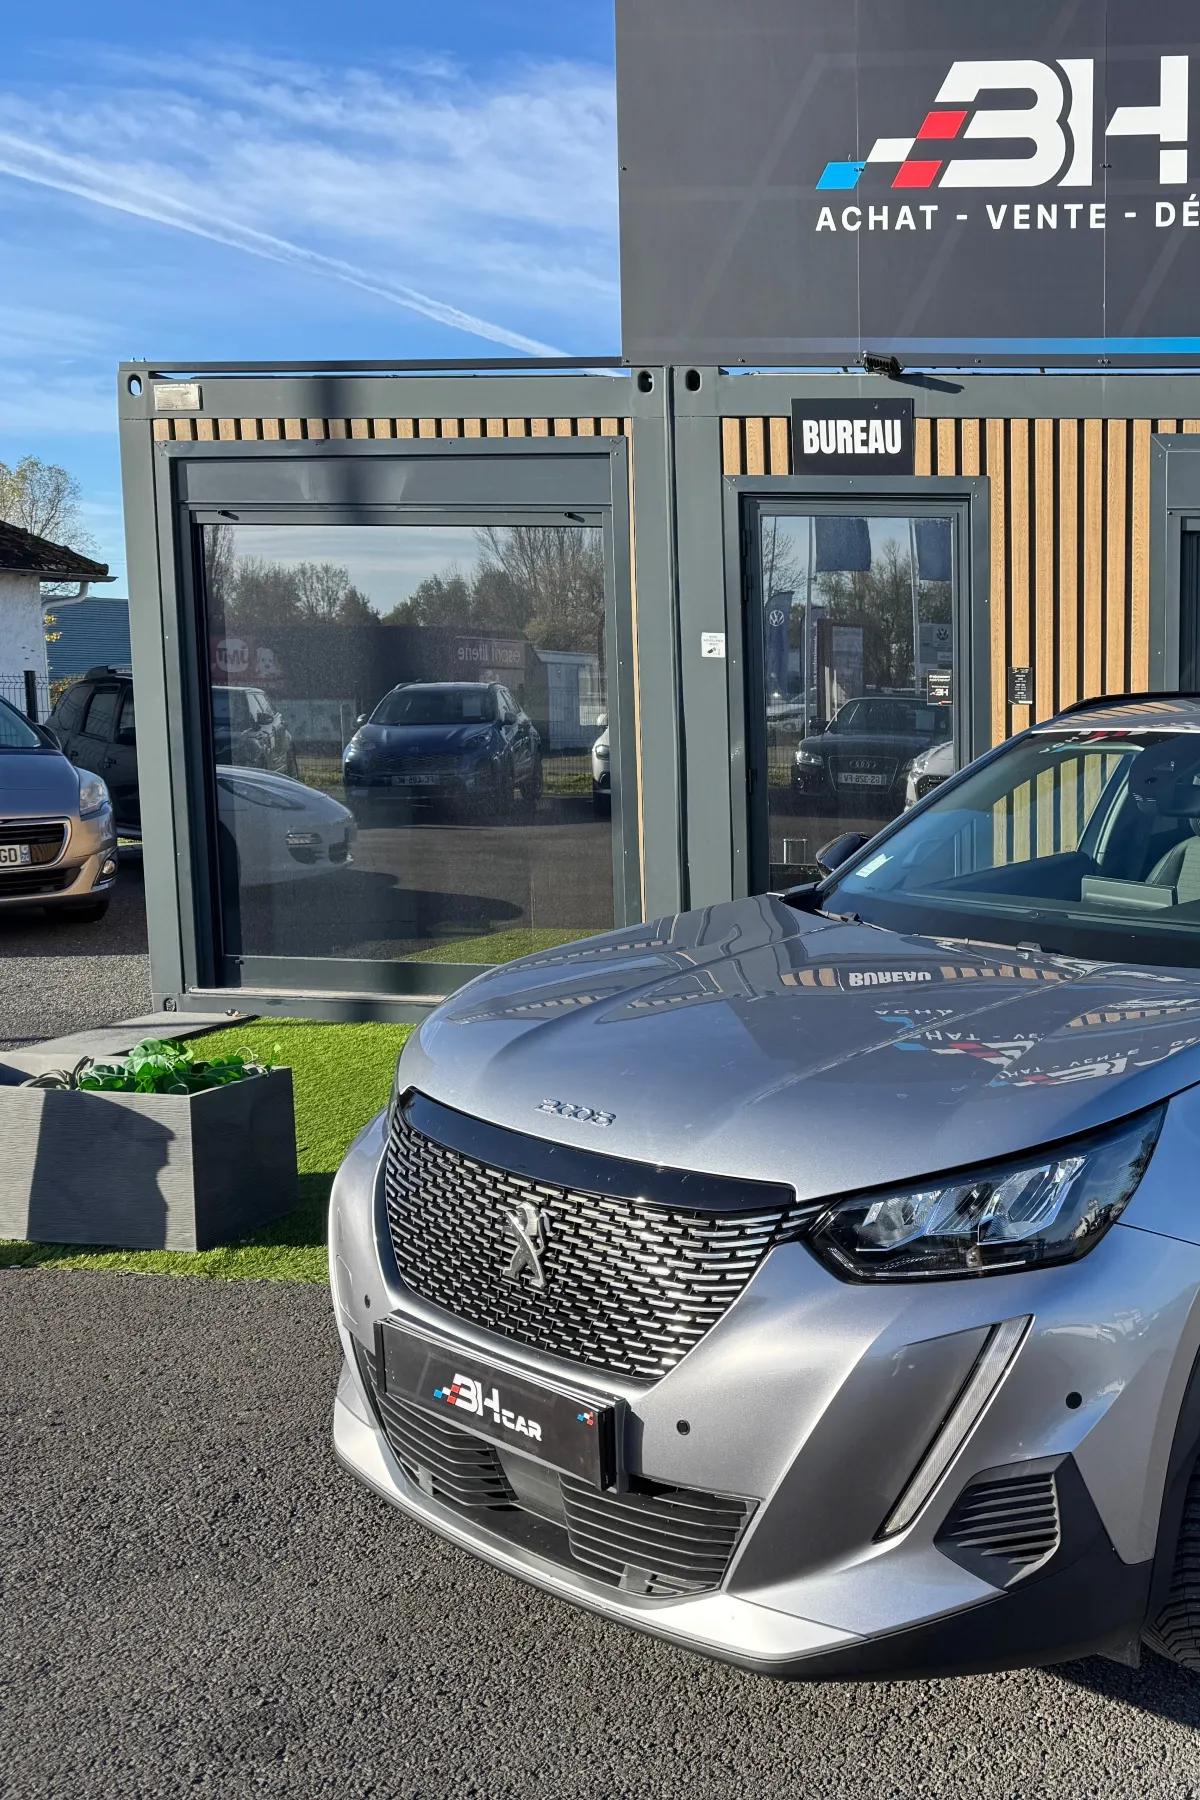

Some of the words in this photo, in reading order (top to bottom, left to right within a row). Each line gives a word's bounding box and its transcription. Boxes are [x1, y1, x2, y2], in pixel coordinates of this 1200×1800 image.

[815, 204, 939, 232] ACHAT
[985, 203, 1106, 230] VENTE
[802, 419, 902, 454] BUREAU
[533, 1098, 617, 1127] 2008
